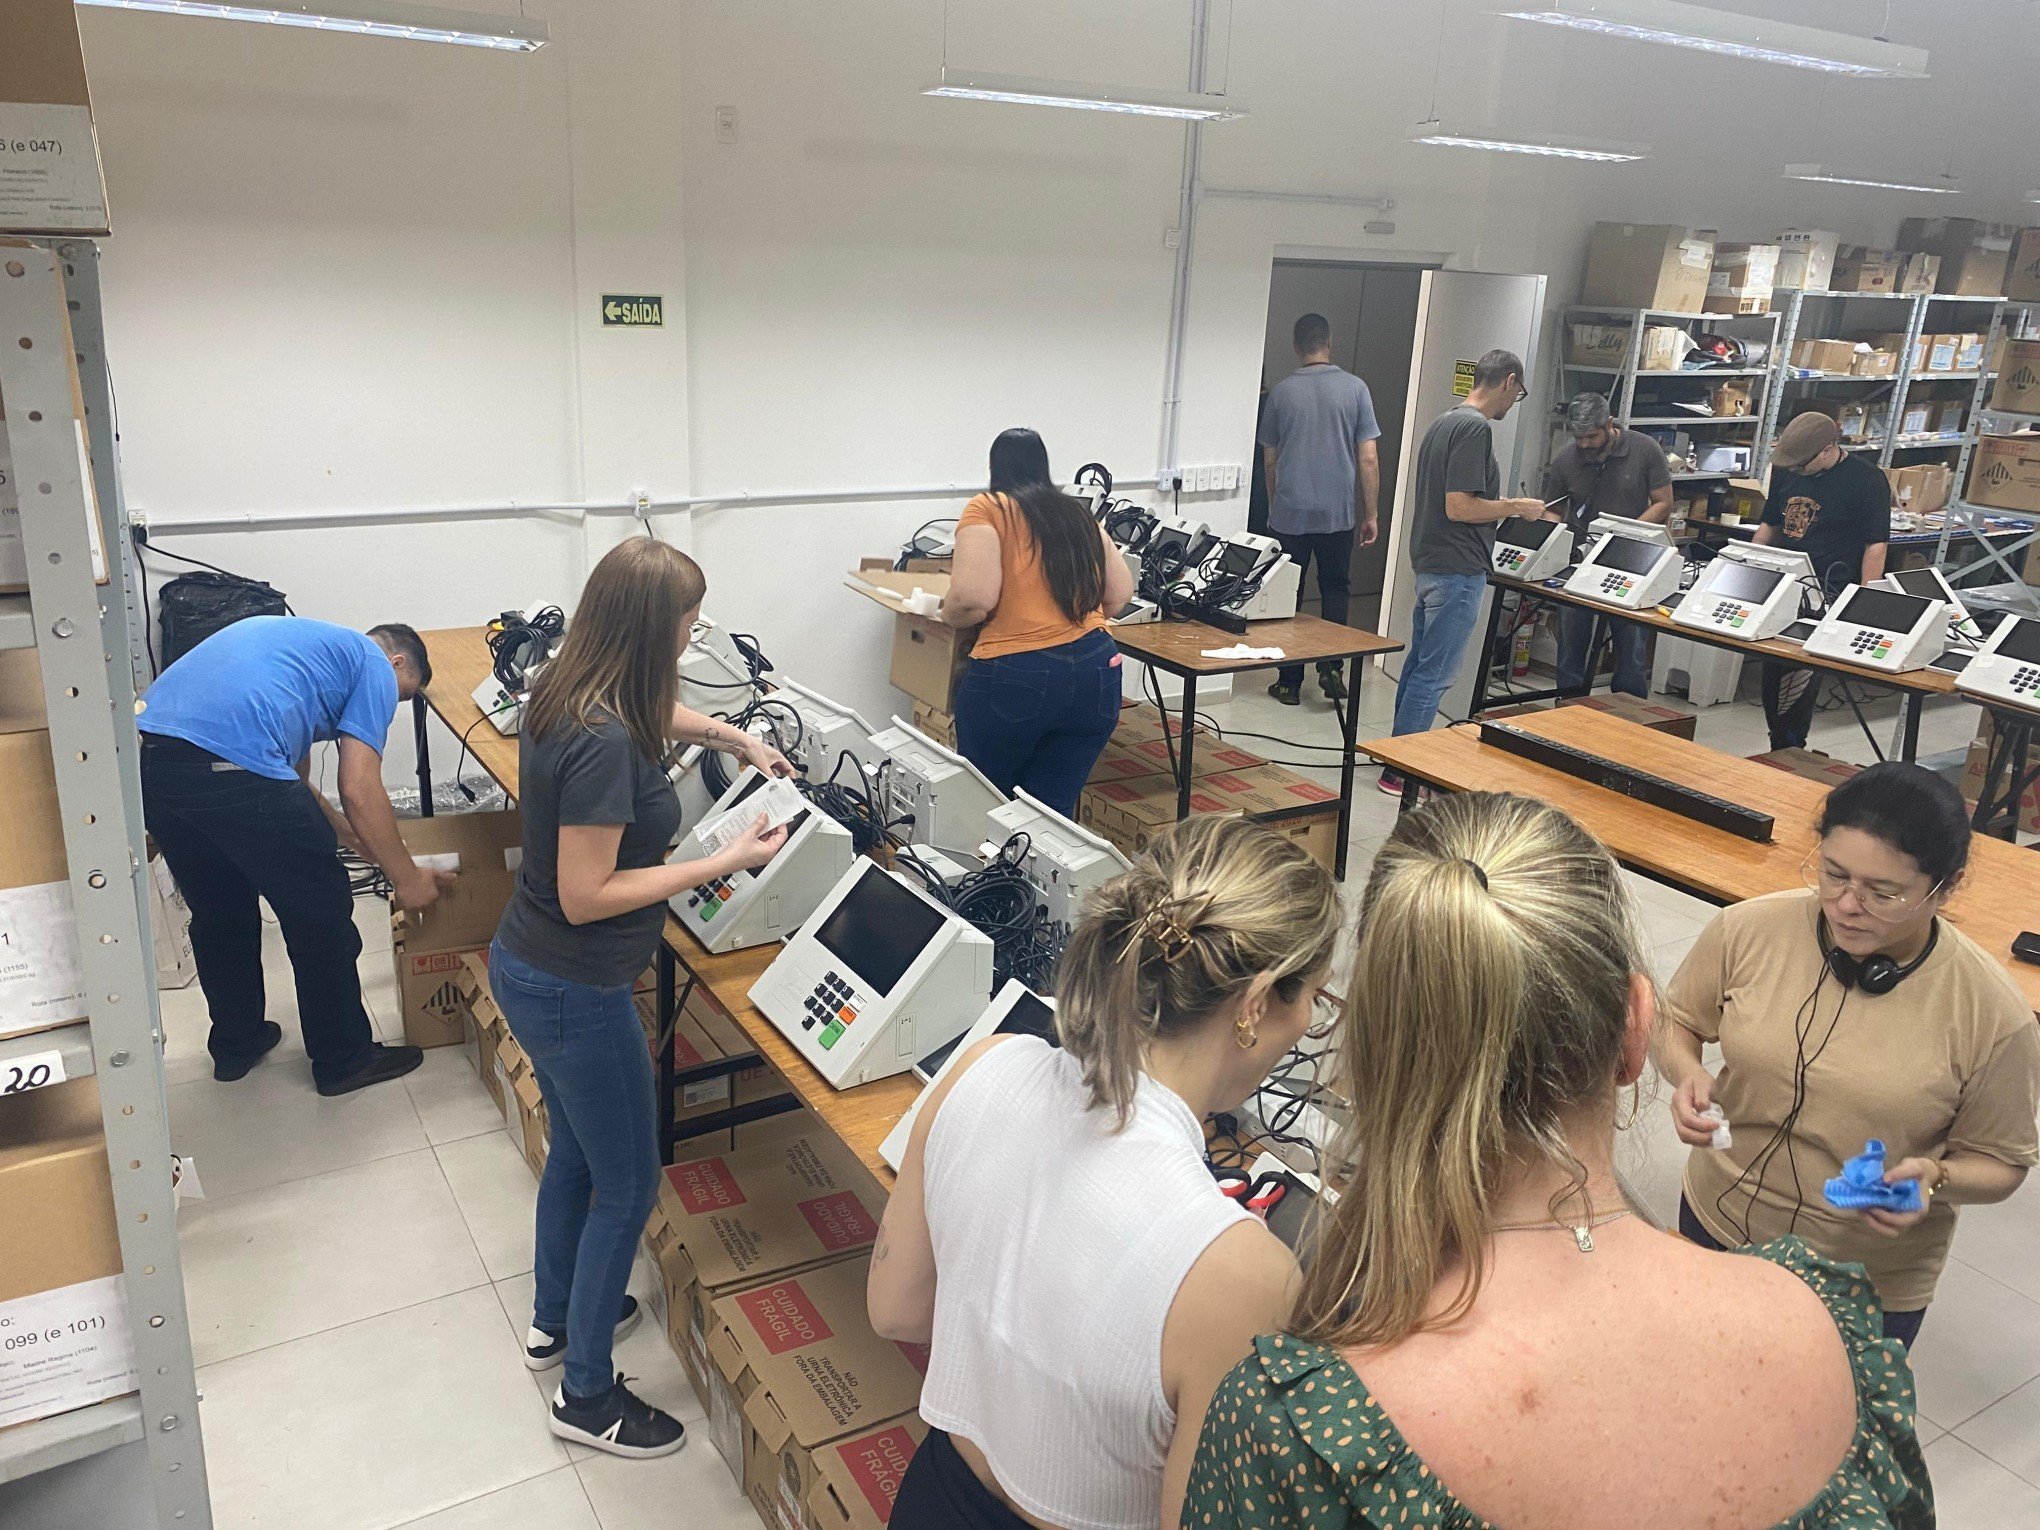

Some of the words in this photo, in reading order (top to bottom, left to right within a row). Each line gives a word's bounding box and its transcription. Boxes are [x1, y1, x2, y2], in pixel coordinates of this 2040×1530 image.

[11, 140, 26, 154] (e
[29, 139, 63, 155] 047)
[622, 298, 661, 323] SAÍDA
[4, 1064, 51, 1093] 20
[699, 1163, 730, 1205] CUIDADO
[813, 1202, 850, 1244] CUIDADO
[5, 1332, 38, 1351] 099
[44, 1328, 61, 1343] (e
[67, 1315, 105, 1334] 101)
[756, 1299, 792, 1342] FRÁGIL
[772, 1288, 815, 1340] CUIDADO
[794, 1355, 810, 1374] FORA
[806, 1374, 818, 1385] DA
[813, 1384, 848, 1427] EMBALAGEM
[807, 1357, 825, 1377] URNA
[820, 1376, 853, 1418] ELETRÔNICA
[820, 1356, 858, 1405] TRANSPORTAR
[843, 1372, 858, 1387] NÃO
